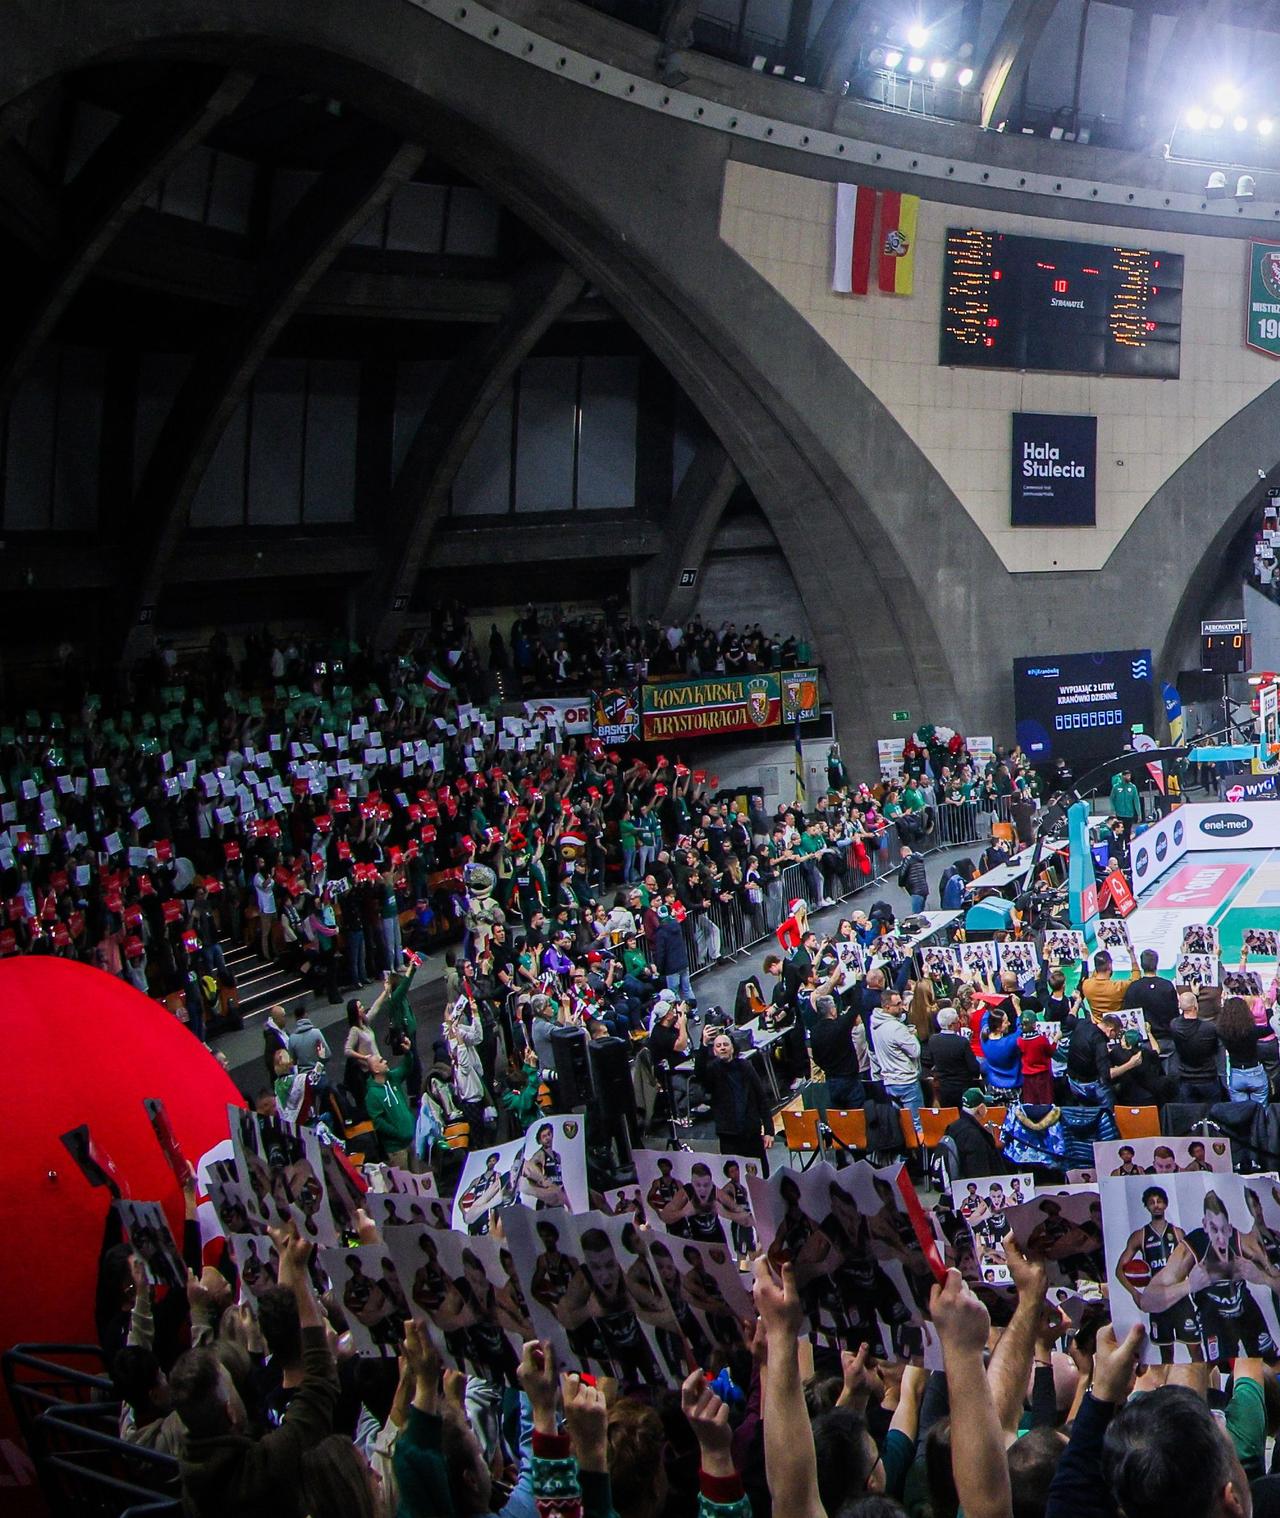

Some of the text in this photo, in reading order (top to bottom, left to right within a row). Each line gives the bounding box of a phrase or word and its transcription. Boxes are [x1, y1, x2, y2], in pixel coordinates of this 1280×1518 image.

[1054, 280, 1067, 293] 10
[1253, 303, 1279, 313] MISTRZ
[1023, 442, 1060, 460] Hala
[1022, 460, 1085, 478] Stulecia
[682, 573, 694, 584] B1
[1204, 623, 1240, 632] AEROWATCH
[1233, 635, 1242, 648] 0
[1098, 683, 1115, 691] LITRY
[653, 682, 744, 709] KOSZYKARSKA
[1090, 692, 1118, 702] DZIENNIE
[653, 708, 748, 735] ARYSTOKRACJA
[598, 724, 634, 737] BASKET
[606, 734, 626, 744] FANS
[1204, 819, 1248, 830] enel-med
